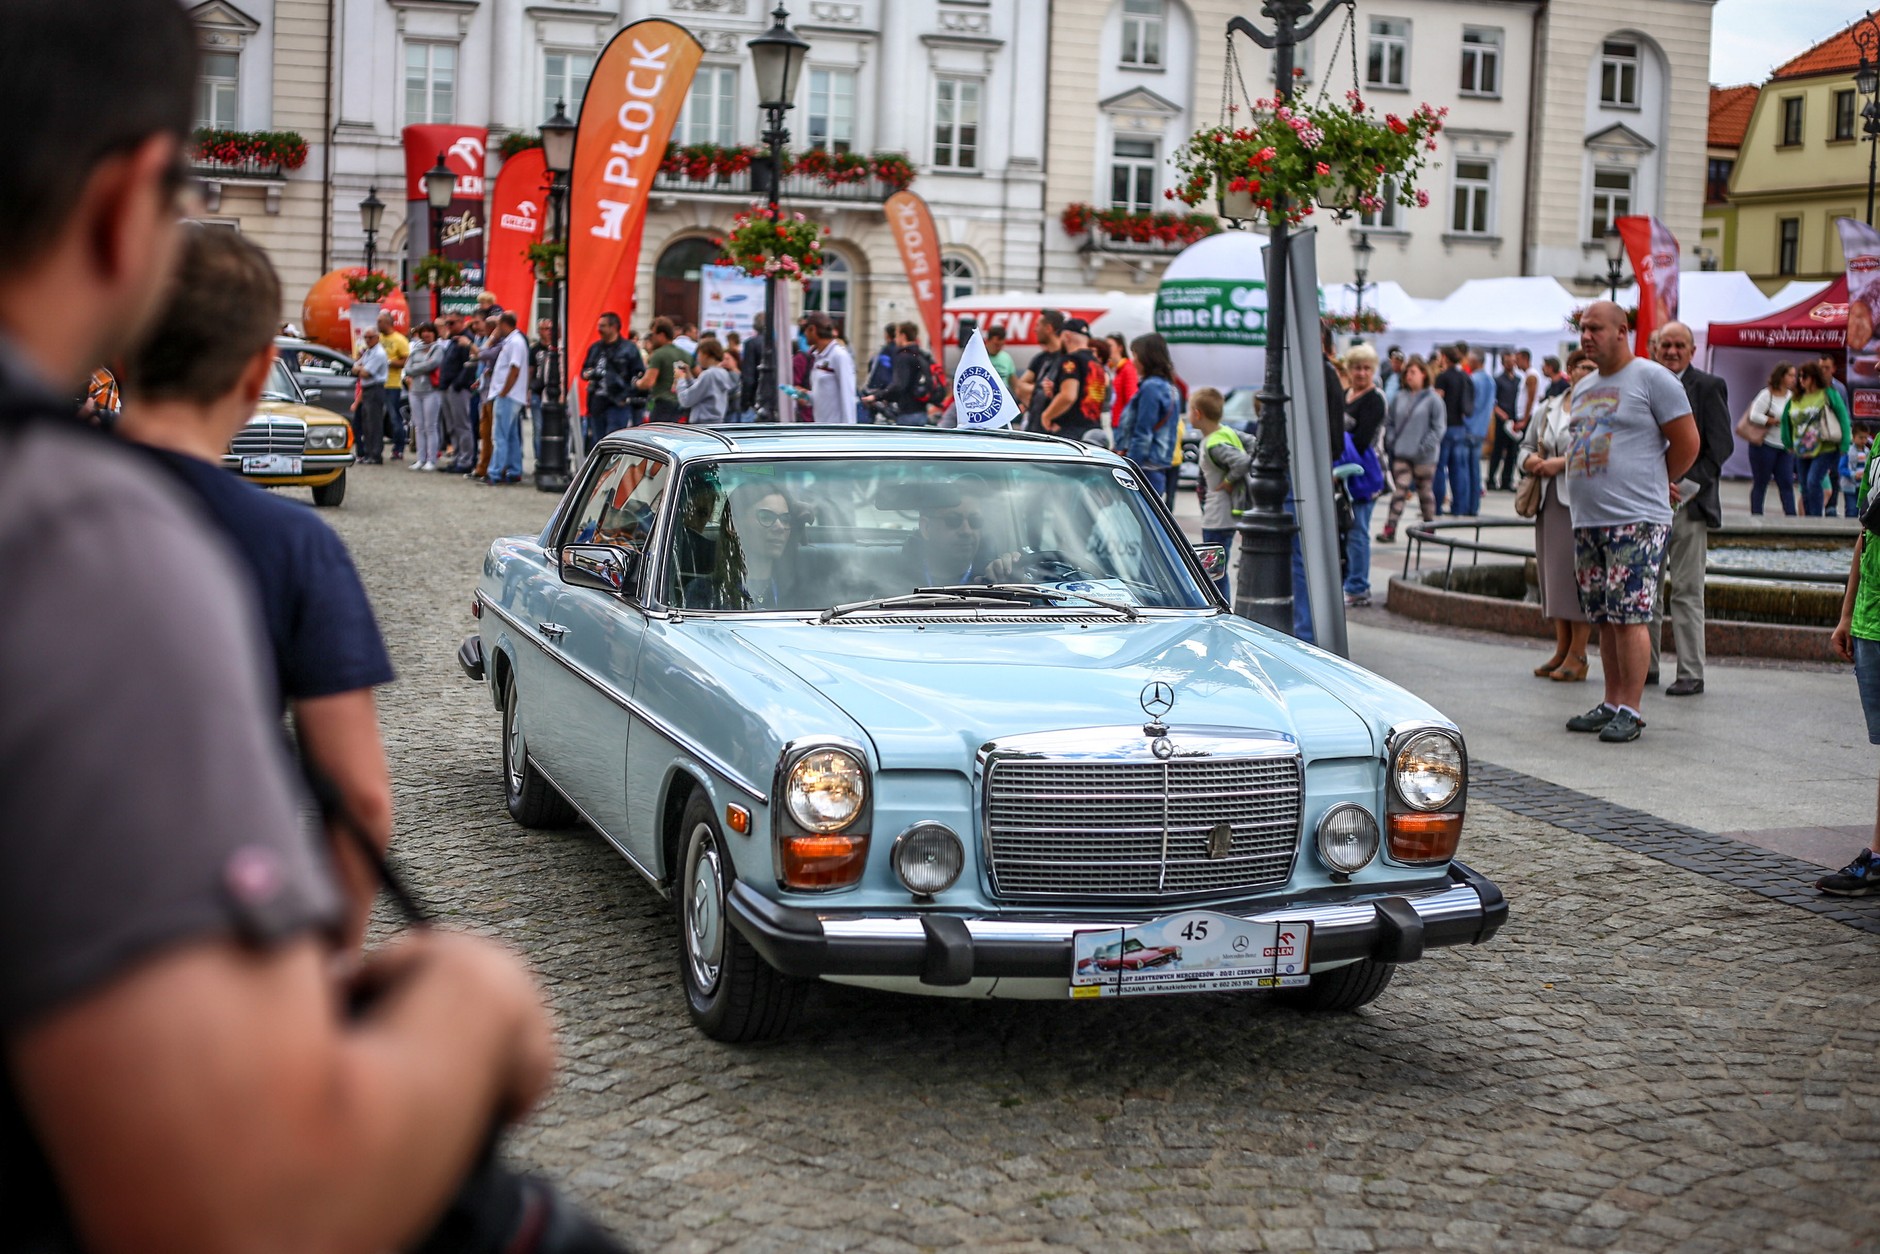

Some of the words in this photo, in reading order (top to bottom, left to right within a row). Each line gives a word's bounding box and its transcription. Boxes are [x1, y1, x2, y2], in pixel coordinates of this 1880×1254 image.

[603, 38, 670, 188] PŁOCK
[418, 174, 485, 195] OLEN
[1156, 303, 1268, 331] ameleo
[1180, 920, 1209, 941] 45
[1134, 973, 1175, 981] ZABYTKOWYCH
[1176, 969, 1214, 979] MERCEDESÓW
[1237, 967, 1263, 976] CZERWCA
[1264, 966, 1277, 974] 201
[1157, 983, 1197, 991] Muszkieterów
